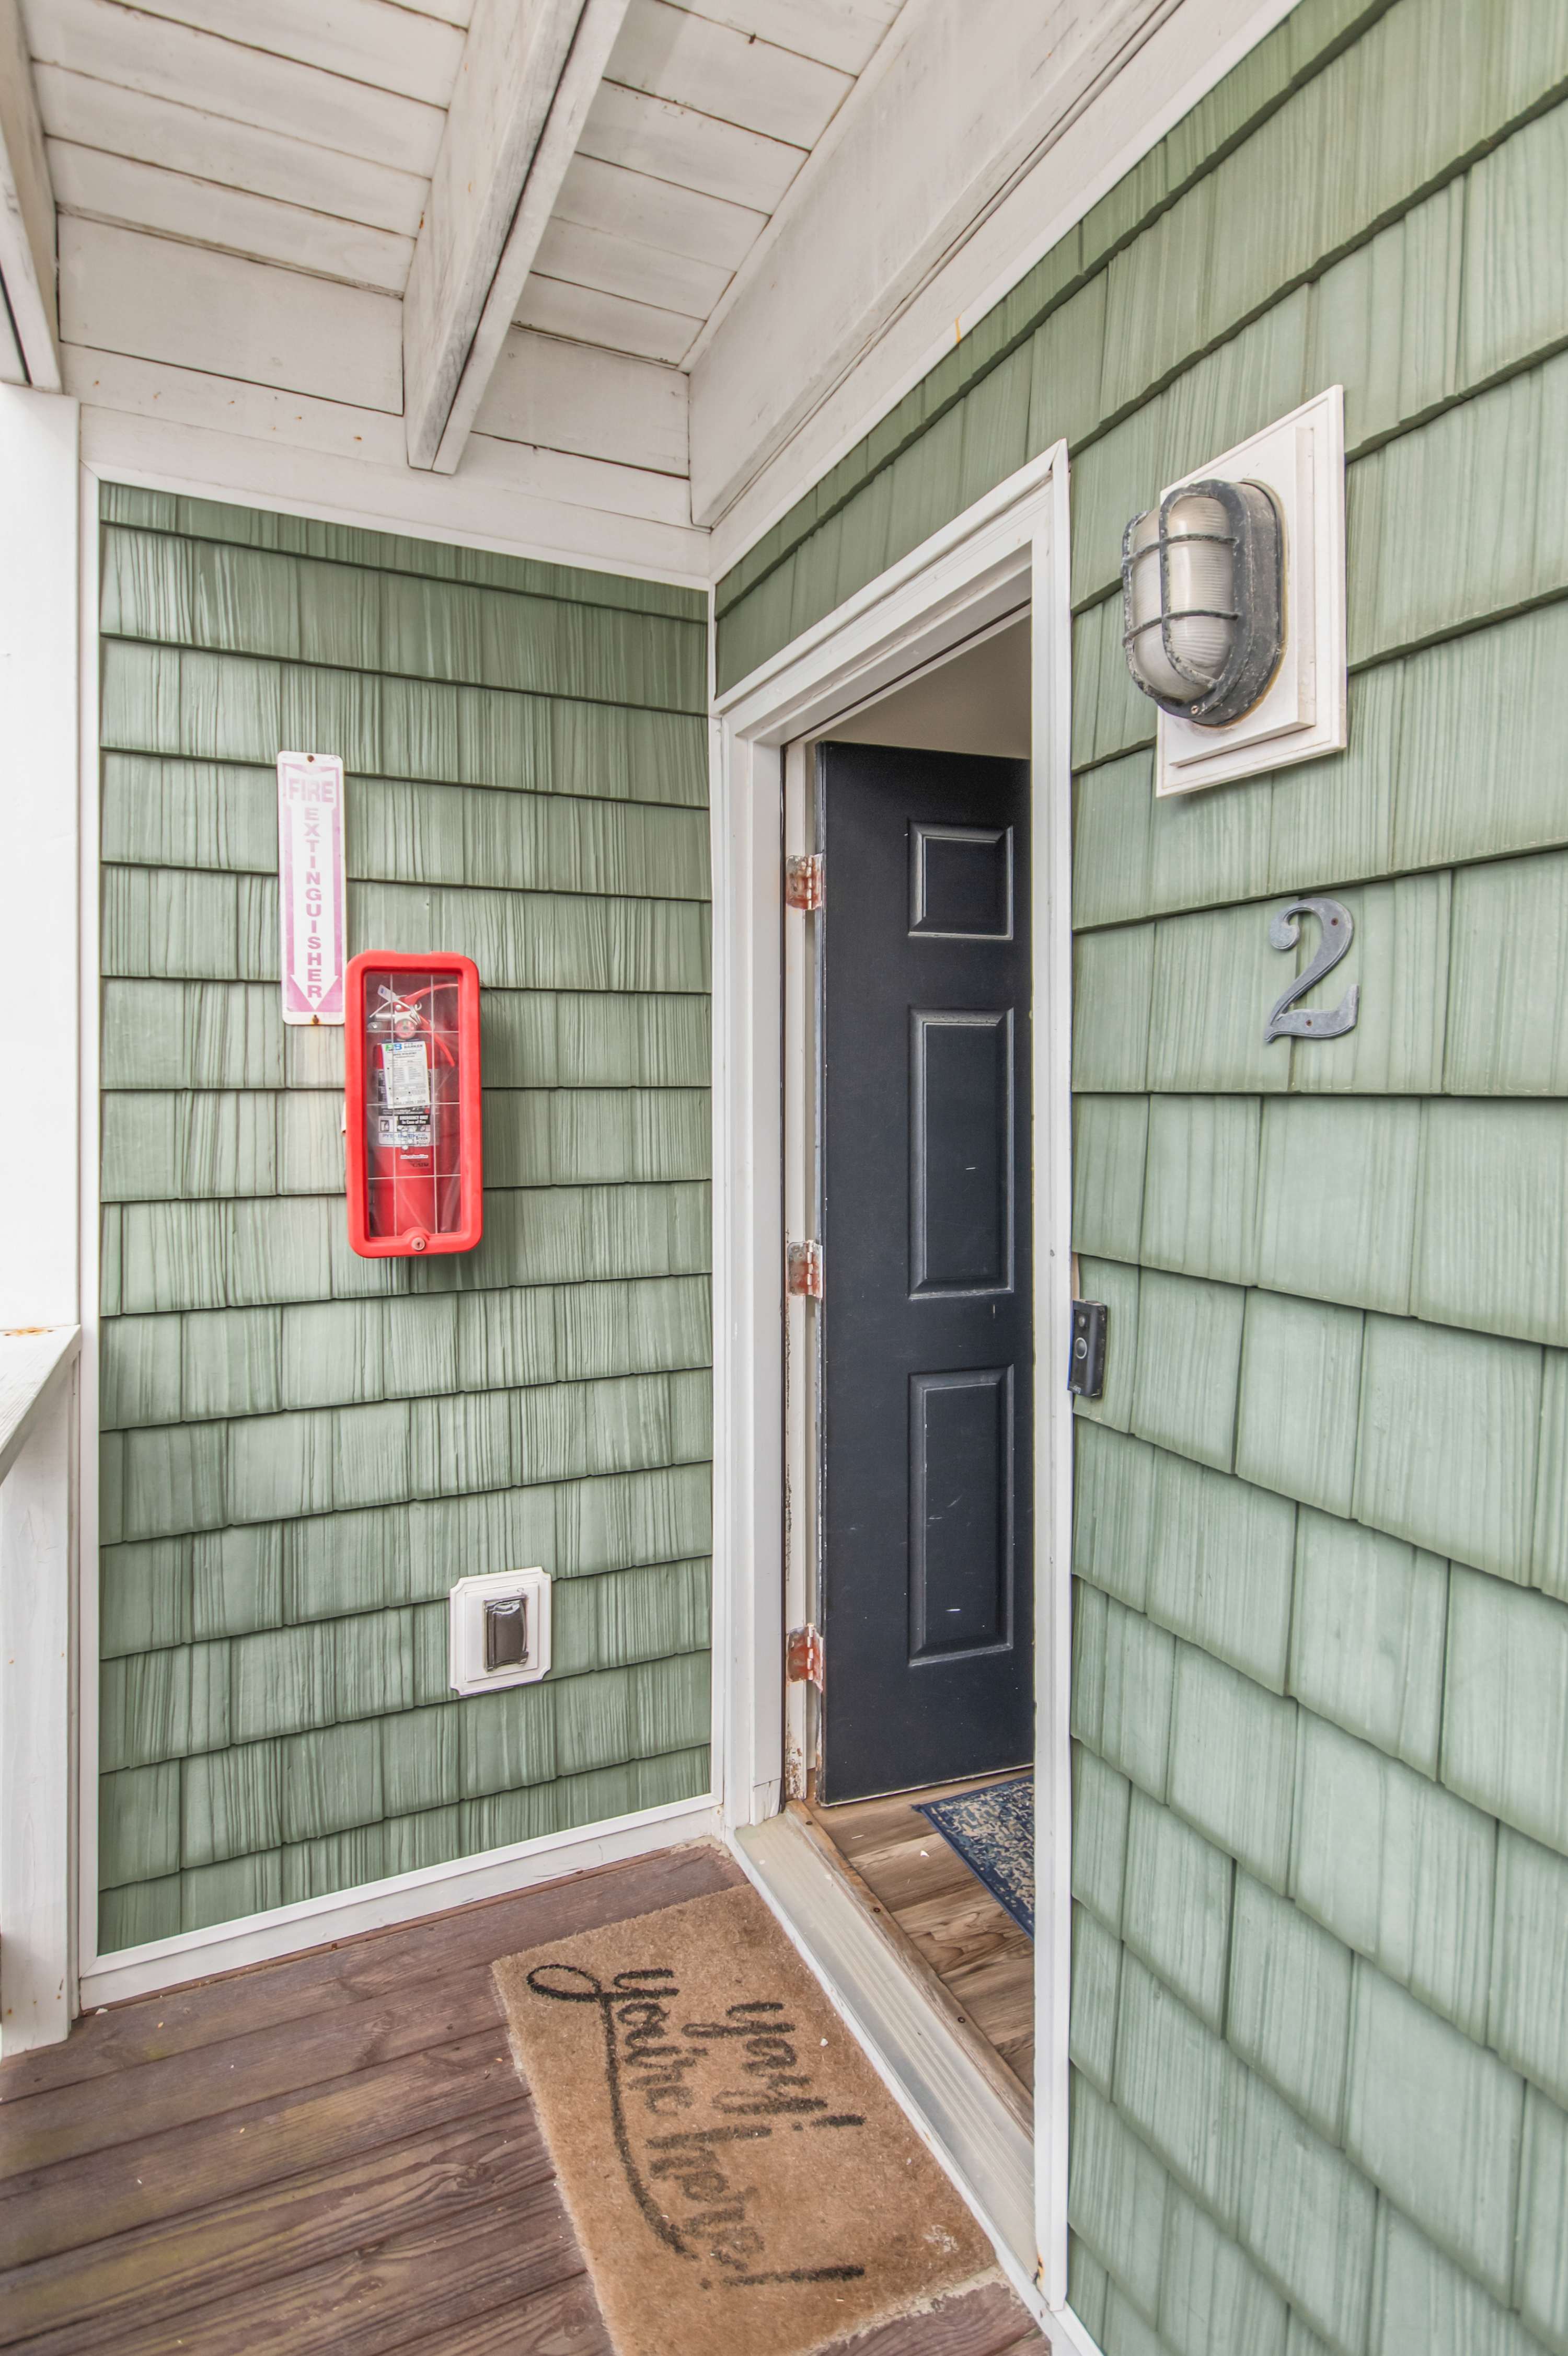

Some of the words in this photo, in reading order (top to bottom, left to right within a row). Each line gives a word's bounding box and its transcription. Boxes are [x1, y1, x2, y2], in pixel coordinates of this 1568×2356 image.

[289, 777, 335, 803] FIRE
[303, 807, 322, 998] EXTINGUISHER
[1263, 897, 1359, 1044] 2
[526, 1963, 708, 2116] you're
[645, 2124, 866, 2290] here!
[681, 2001, 867, 2131] yay!
